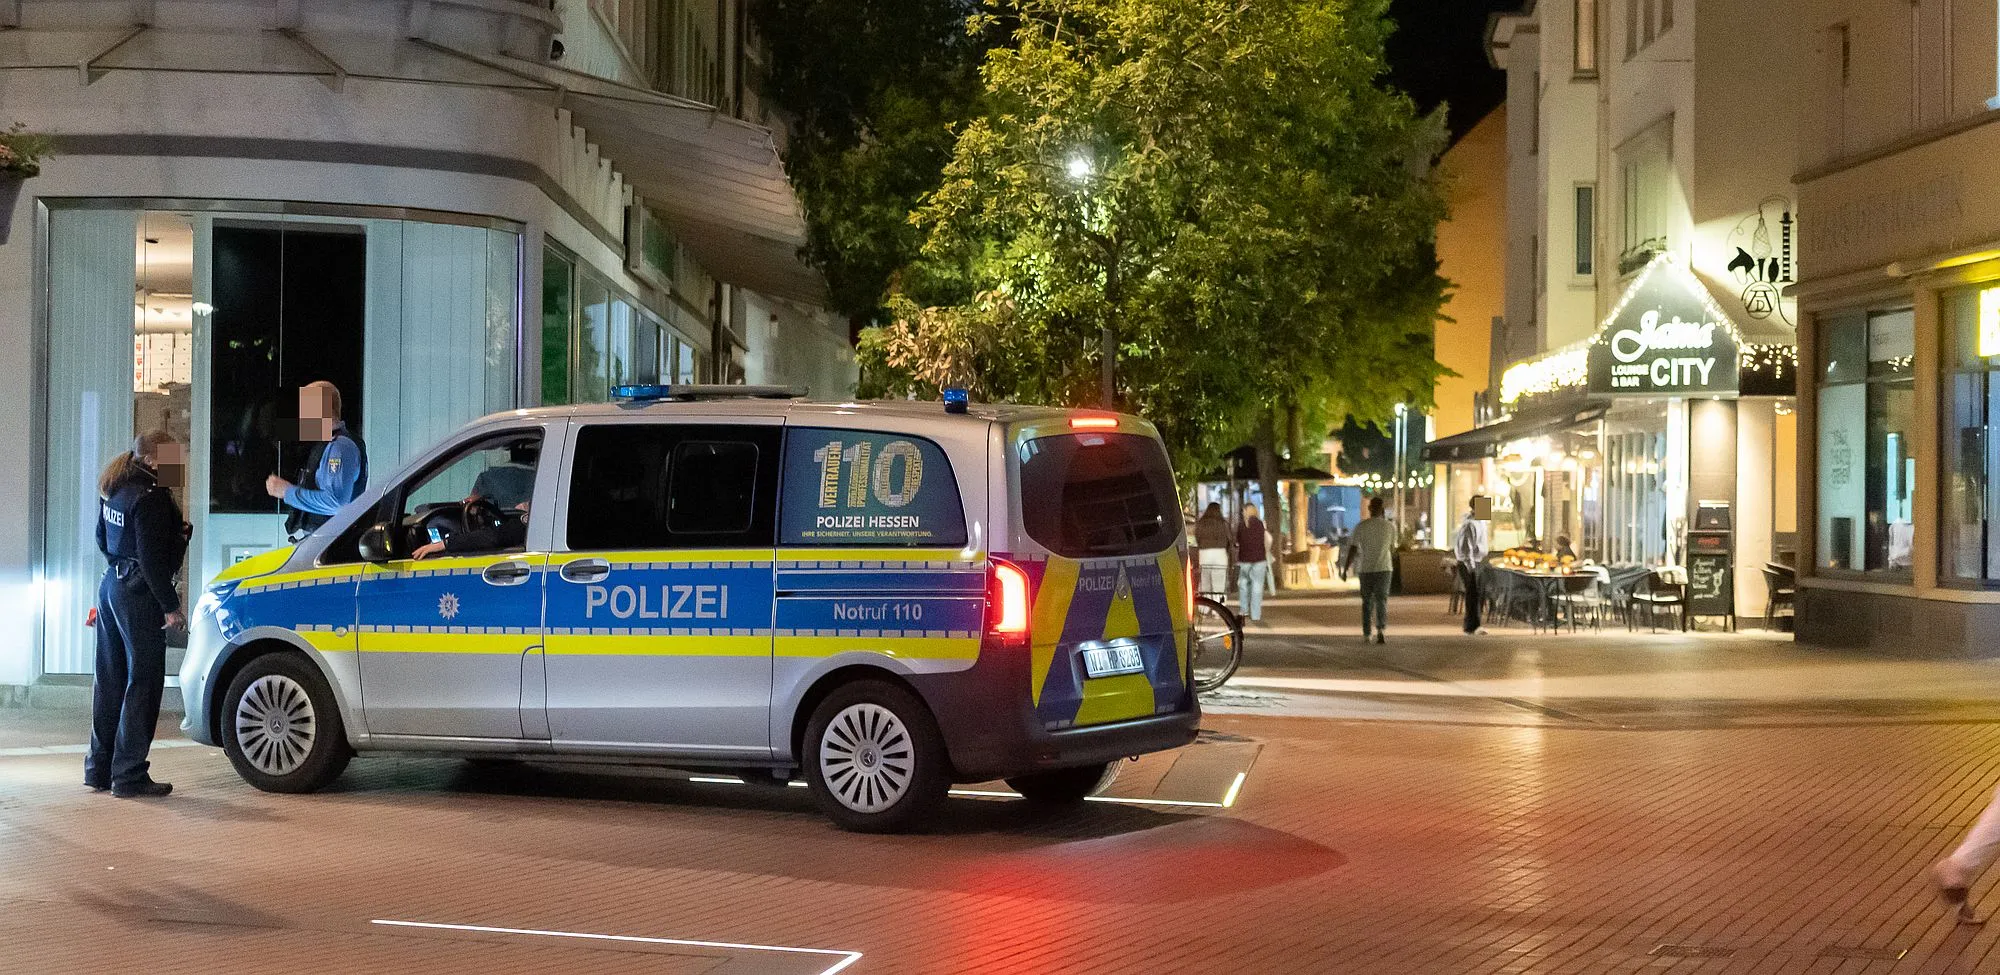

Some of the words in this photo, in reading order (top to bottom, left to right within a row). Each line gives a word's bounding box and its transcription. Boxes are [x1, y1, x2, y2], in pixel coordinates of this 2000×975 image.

[1611, 364, 1649, 375] LOUNGE
[1650, 357, 1716, 386] CITY
[1611, 376, 1619, 387] &
[1620, 376, 1640, 387] BAR
[814, 441, 923, 508] 110
[817, 516, 865, 528] POLIZEI
[869, 516, 919, 528] HESSEN
[1079, 576, 1114, 592] POLIZEI
[585, 585, 728, 619] POLIZEI
[833, 602, 888, 620] Notruf
[892, 603, 922, 621] 110
